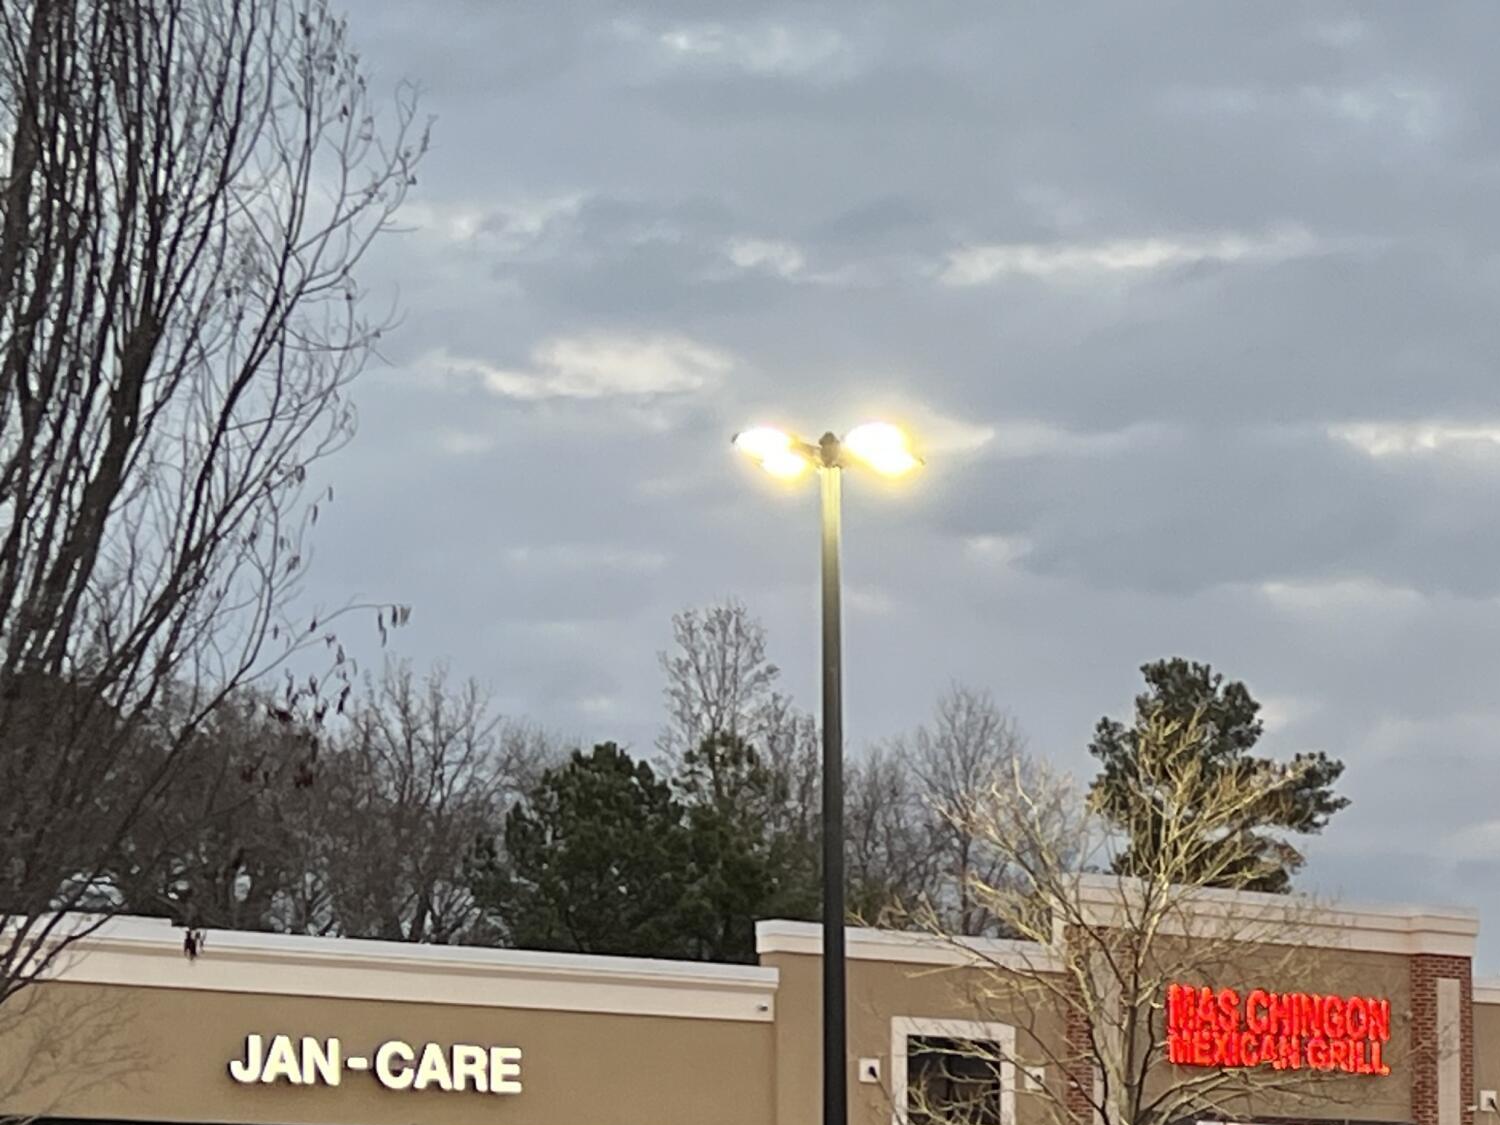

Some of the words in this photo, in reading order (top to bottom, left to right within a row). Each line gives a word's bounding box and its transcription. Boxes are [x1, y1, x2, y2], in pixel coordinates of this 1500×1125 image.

[1168, 984, 1240, 1030] MAS
[1246, 989, 1391, 1042] CHINGON
[229, 1034, 523, 1094] JAN-CARE
[1168, 1030, 1301, 1071] MEXICAN
[1307, 1037, 1391, 1076] GRILL
